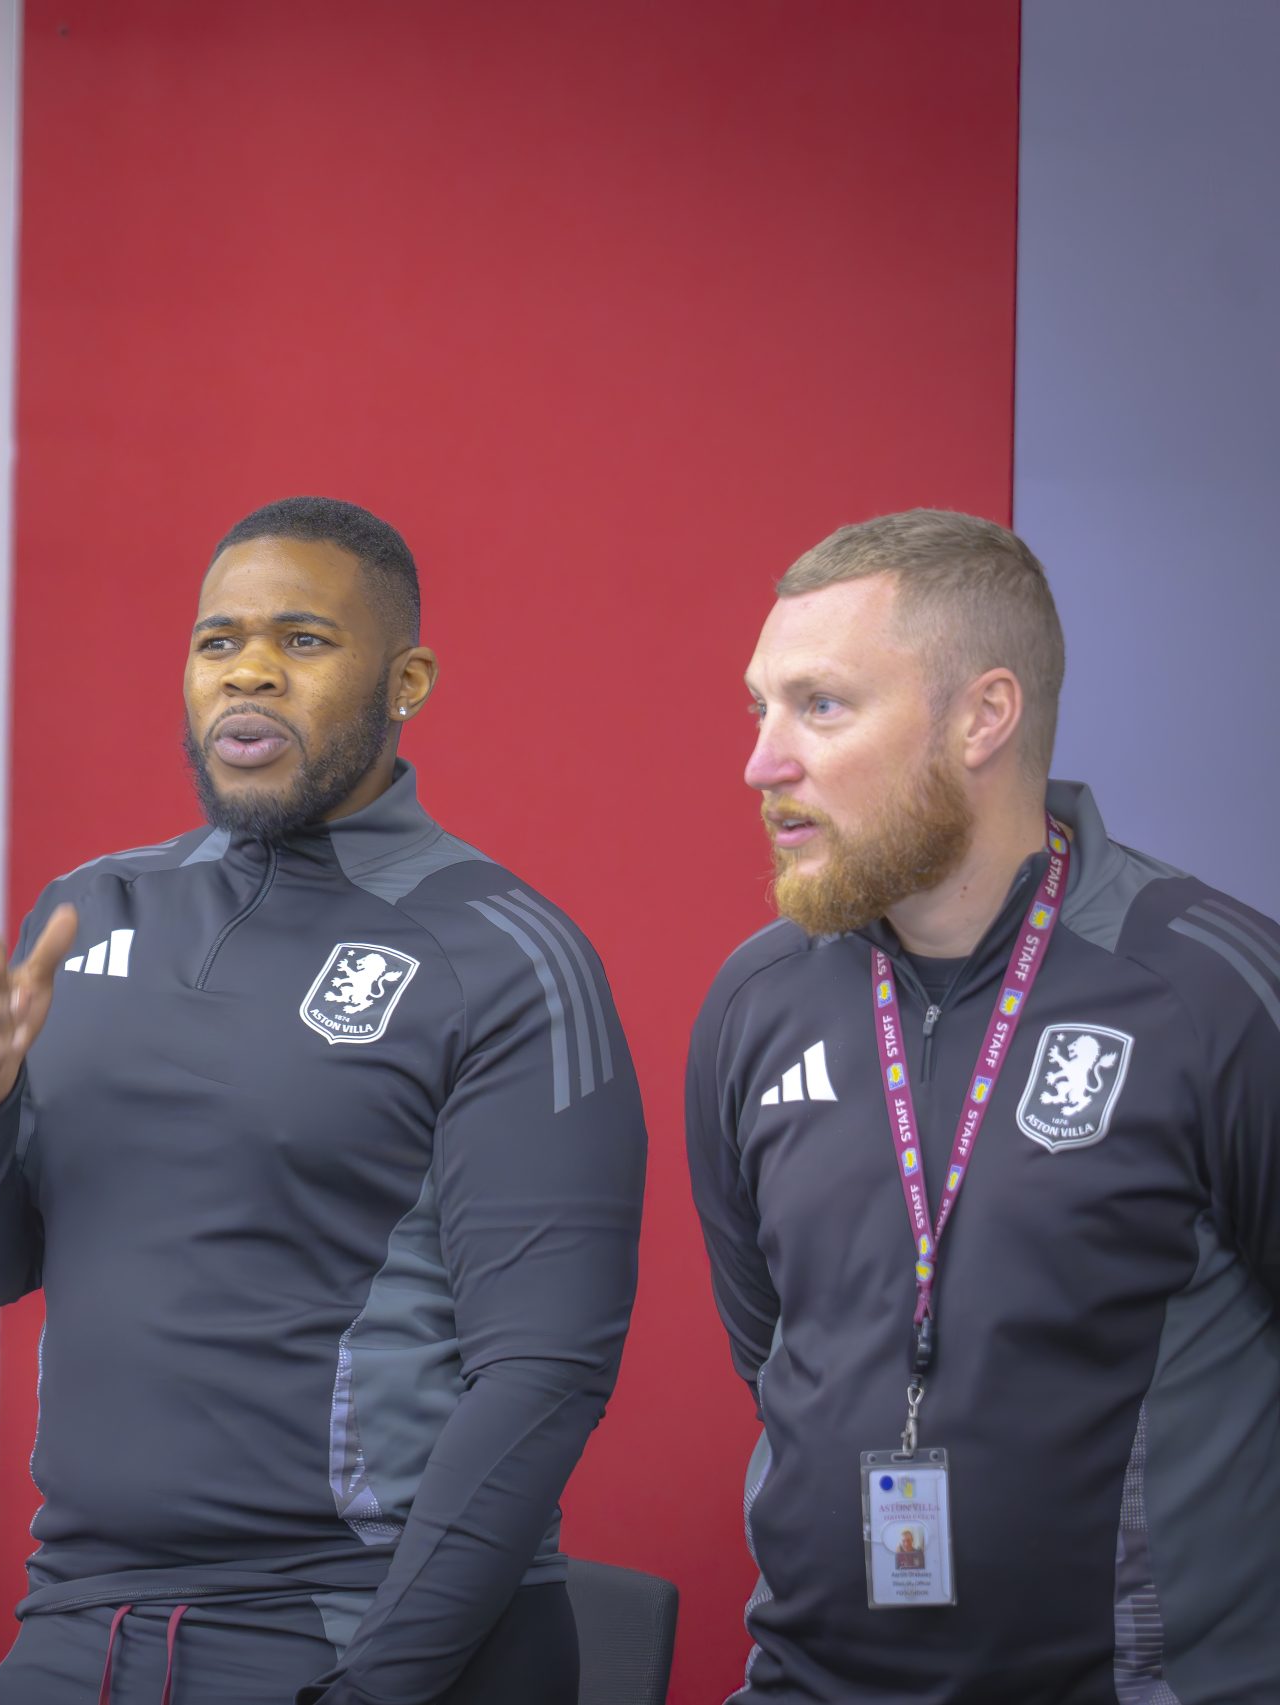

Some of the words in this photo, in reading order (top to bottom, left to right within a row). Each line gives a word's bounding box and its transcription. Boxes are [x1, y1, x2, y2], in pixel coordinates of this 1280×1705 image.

[1044, 855, 1063, 898] STAFF
[1014, 934, 1040, 981] STAFF
[310, 1008, 341, 1031] ASTON
[342, 1024, 374, 1033] VILLA
[334, 1014, 350, 1022] 1874
[882, 1015, 898, 1058] STAFF
[985, 1021, 1009, 1068] STAFF
[894, 1098, 912, 1143] STAFF
[957, 1109, 979, 1157] STAFF
[1025, 1113, 1059, 1137] ASTON
[1060, 1122, 1094, 1138] VILLA
[910, 1184, 926, 1230] STAFF
